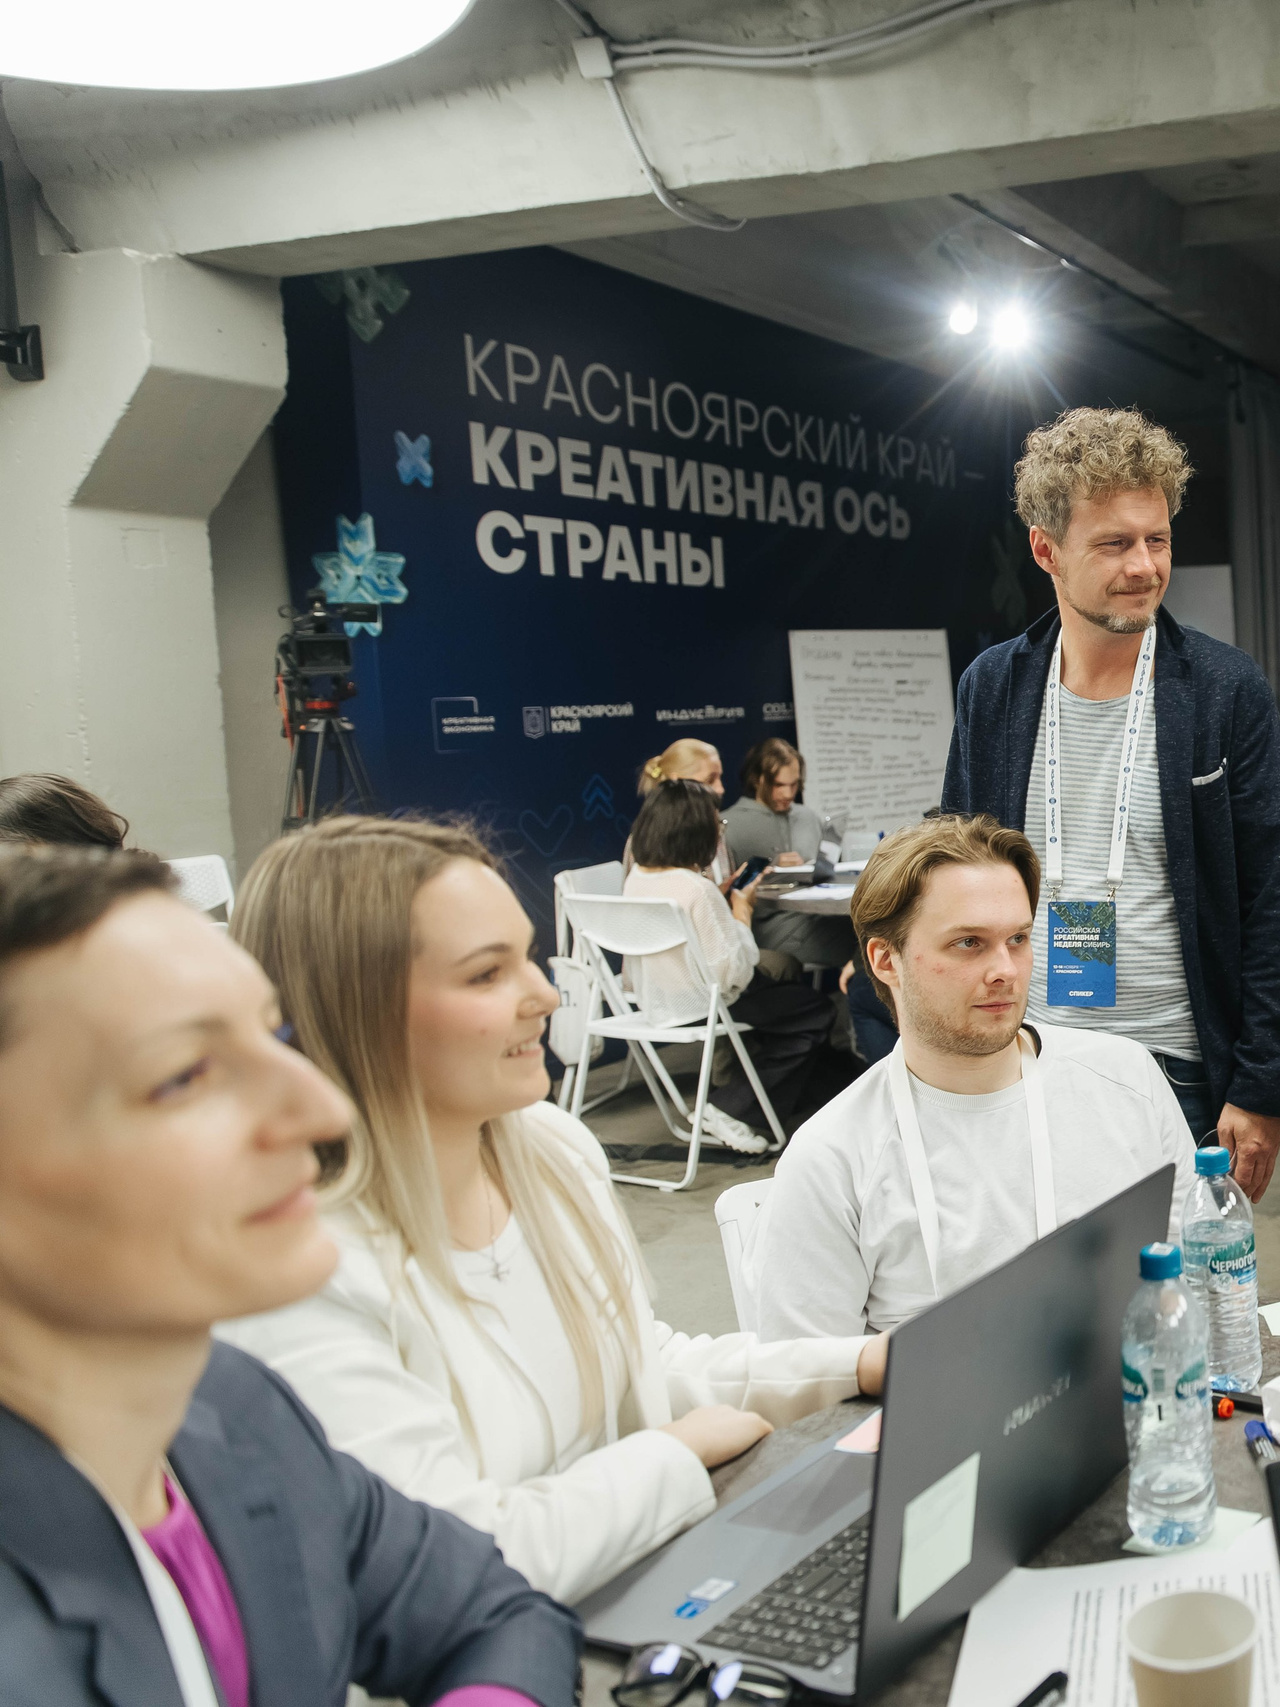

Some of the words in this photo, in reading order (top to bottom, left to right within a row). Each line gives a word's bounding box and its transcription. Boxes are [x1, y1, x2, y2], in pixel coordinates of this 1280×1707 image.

[463, 333, 868, 472] КРАСНОЯРСКИЙ
[877, 431, 956, 489] КРАЙ
[468, 420, 826, 530] КРЕАТИВНАЯ
[833, 486, 912, 540] ОСЬ
[475, 510, 726, 588] СТРАНЫ
[550, 702, 634, 719] КРАСНОЯРСКИЙ
[551, 718, 581, 734] КРАЙ
